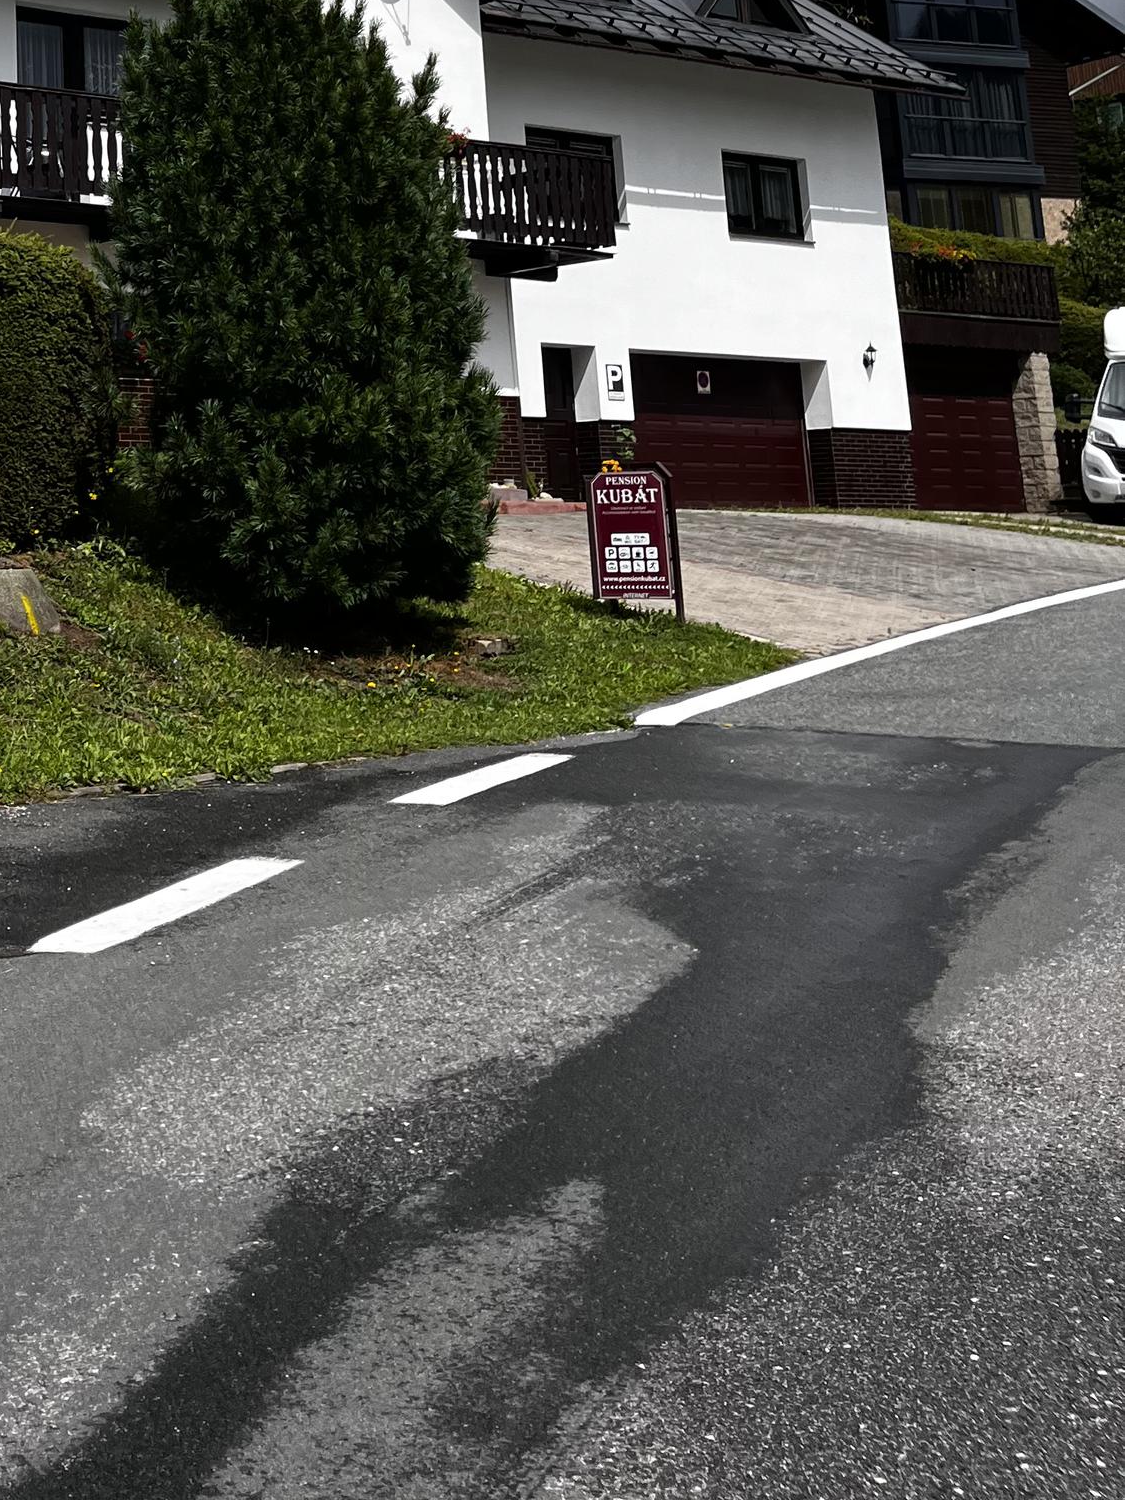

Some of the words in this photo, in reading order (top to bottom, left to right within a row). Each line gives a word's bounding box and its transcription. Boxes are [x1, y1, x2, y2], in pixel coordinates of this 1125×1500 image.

[607, 365, 622, 390] P
[605, 475, 647, 486] PENSION
[596, 485, 658, 504] KUBÁT
[603, 575, 666, 583] www.pensionkubat.cz
